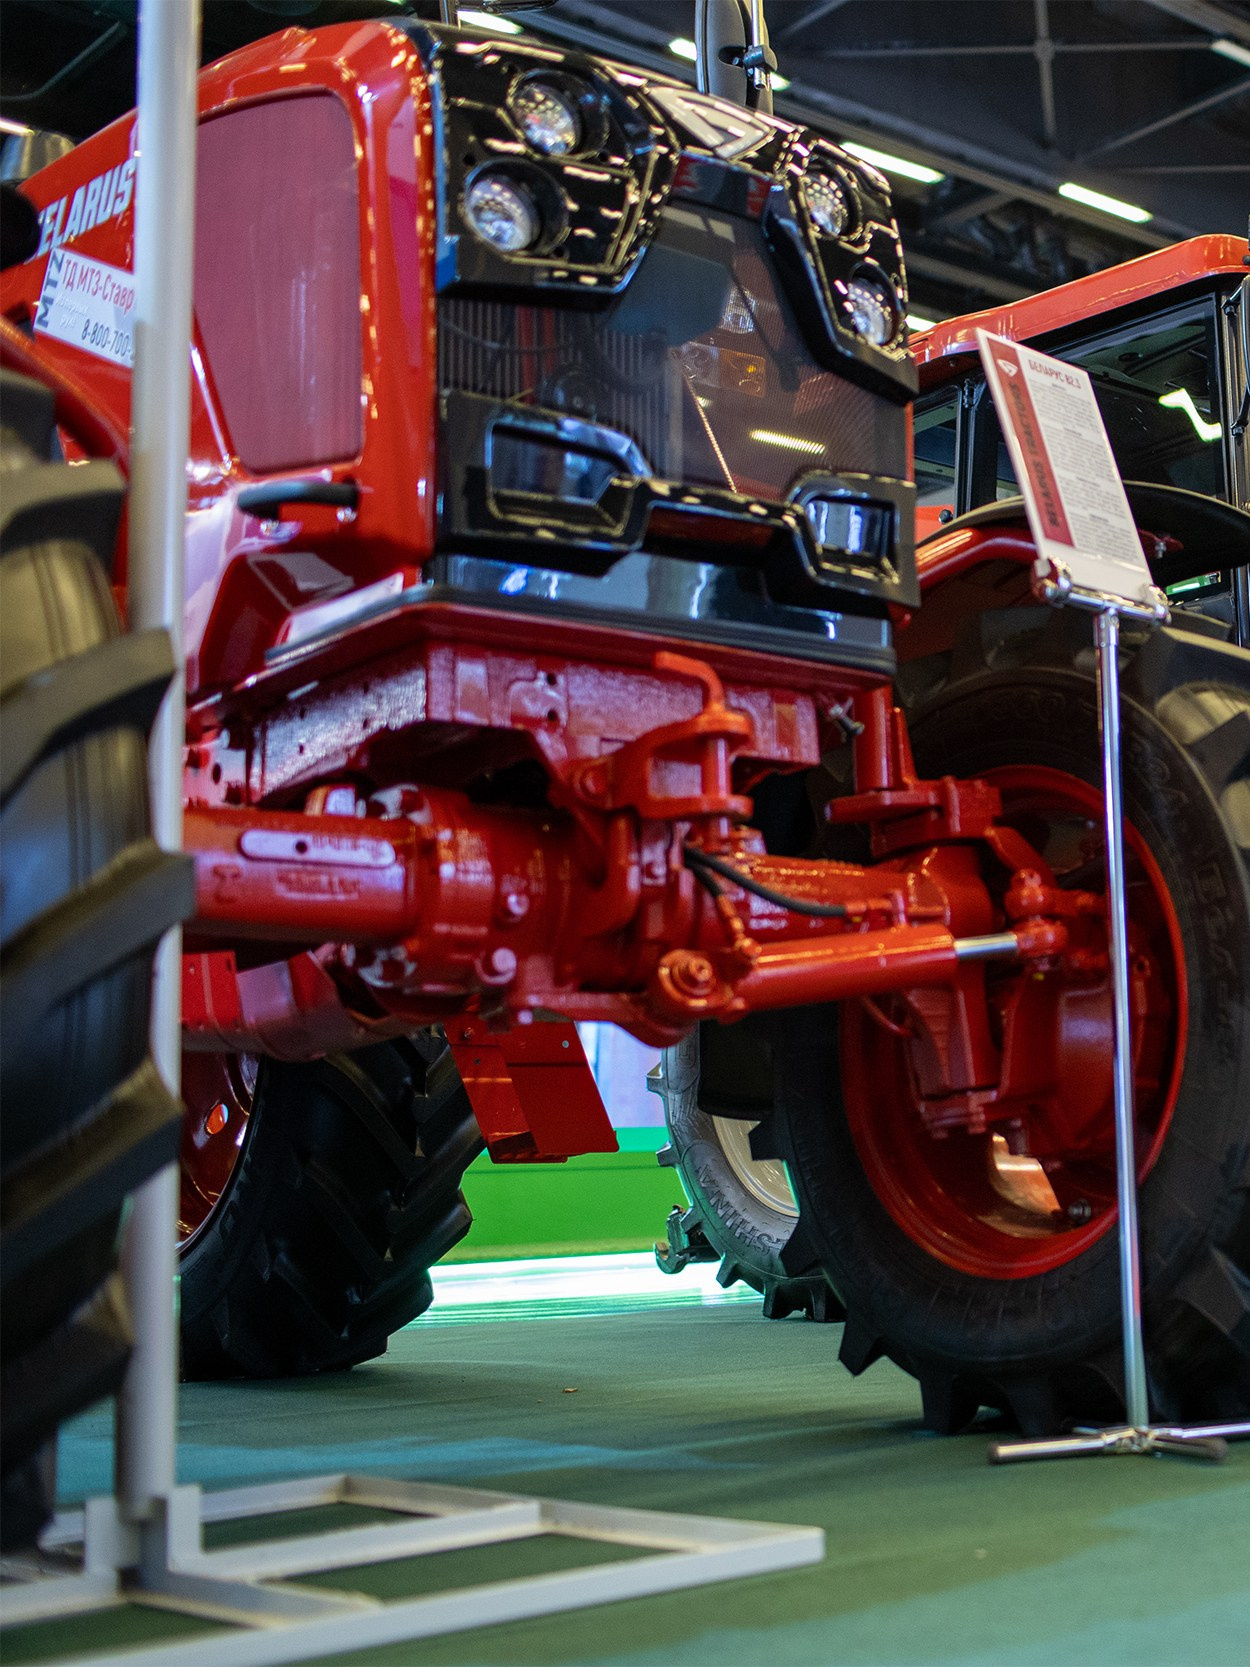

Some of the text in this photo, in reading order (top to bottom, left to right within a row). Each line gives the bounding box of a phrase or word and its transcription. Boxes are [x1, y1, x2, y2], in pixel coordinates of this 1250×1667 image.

[26, 158, 136, 263] ELARUS
[36, 252, 65, 328] MTZ
[62, 259, 77, 292] ТД
[77, 266, 135, 316] МТЗ-Ставр
[81, 318, 135, 361] 8-800-700-
[1028, 359, 1066, 383] БЕЛАРУС
[1009, 382, 1060, 528] BELARUS TRACTORS
